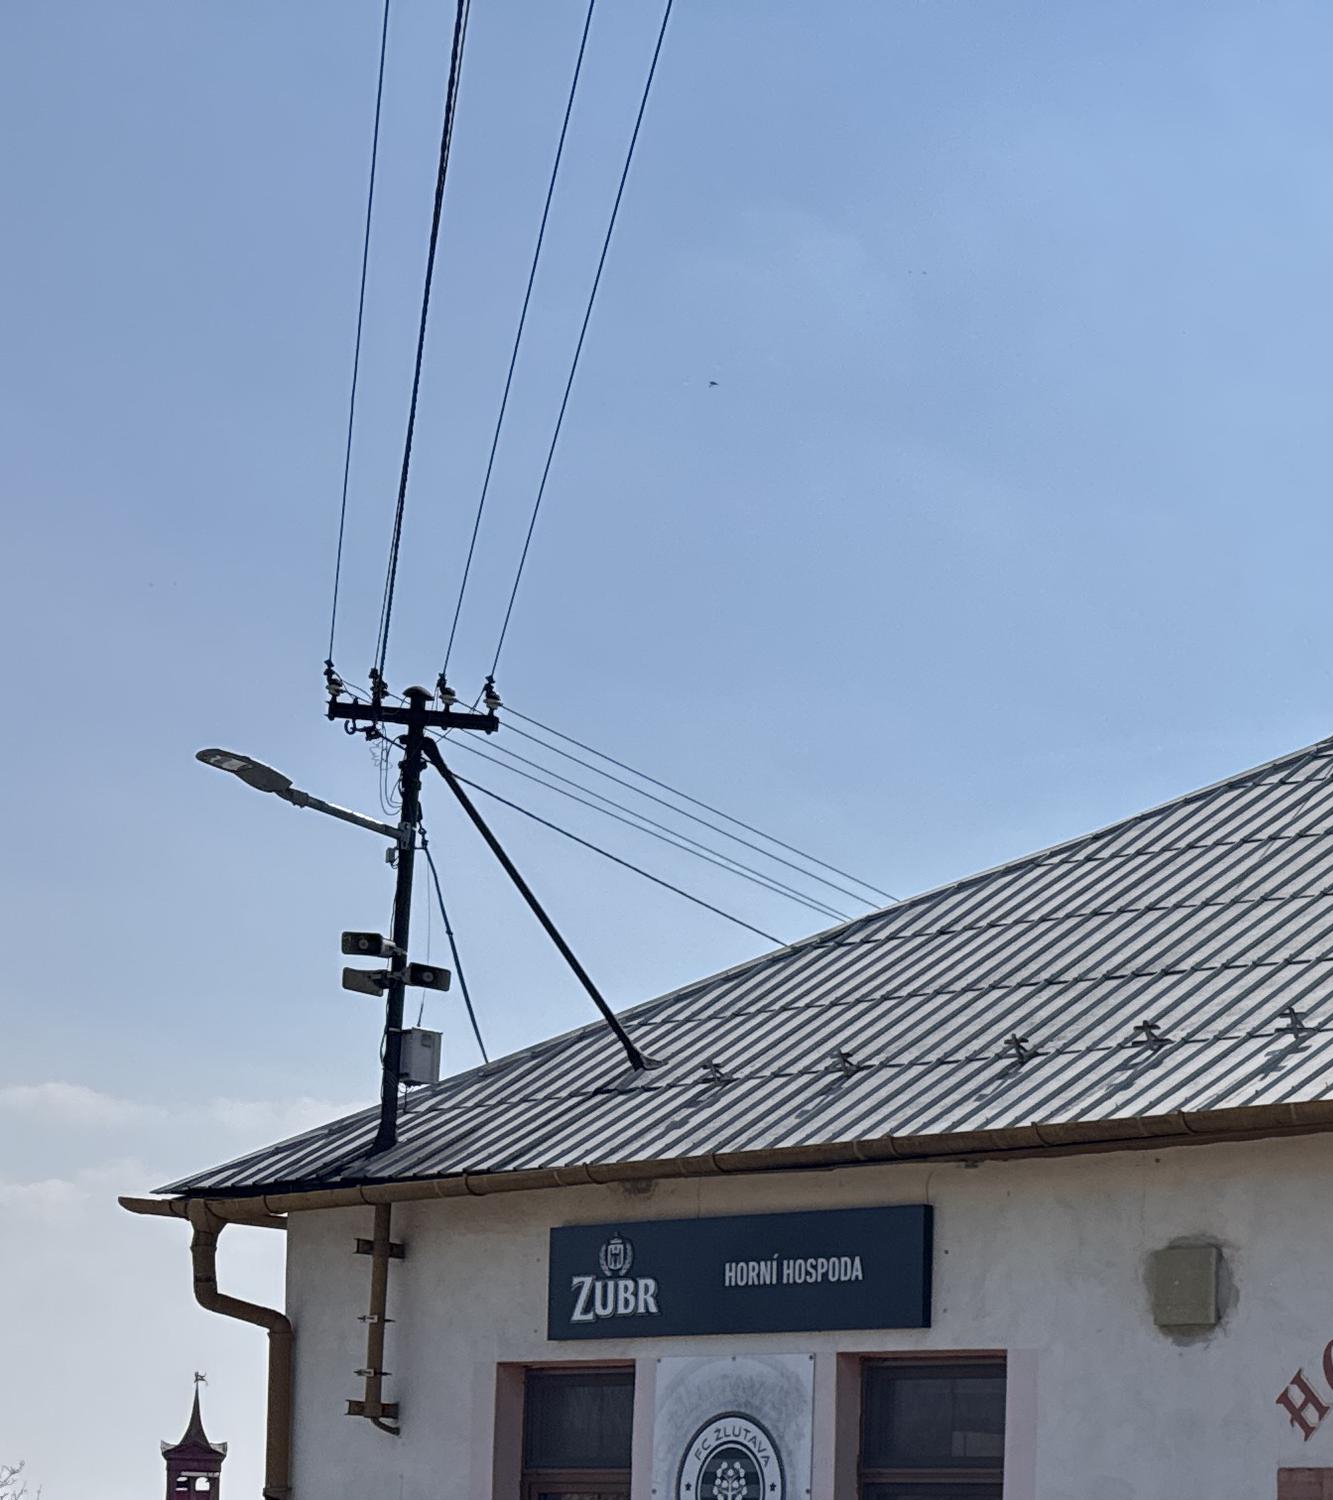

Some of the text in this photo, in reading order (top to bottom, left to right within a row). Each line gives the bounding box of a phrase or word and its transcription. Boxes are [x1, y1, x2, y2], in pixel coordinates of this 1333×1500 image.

[724, 1253, 863, 1286] HORNÍ HOSPODA
[570, 1275, 659, 1322] ZUBR
[694, 1438, 712, 1461] FC
